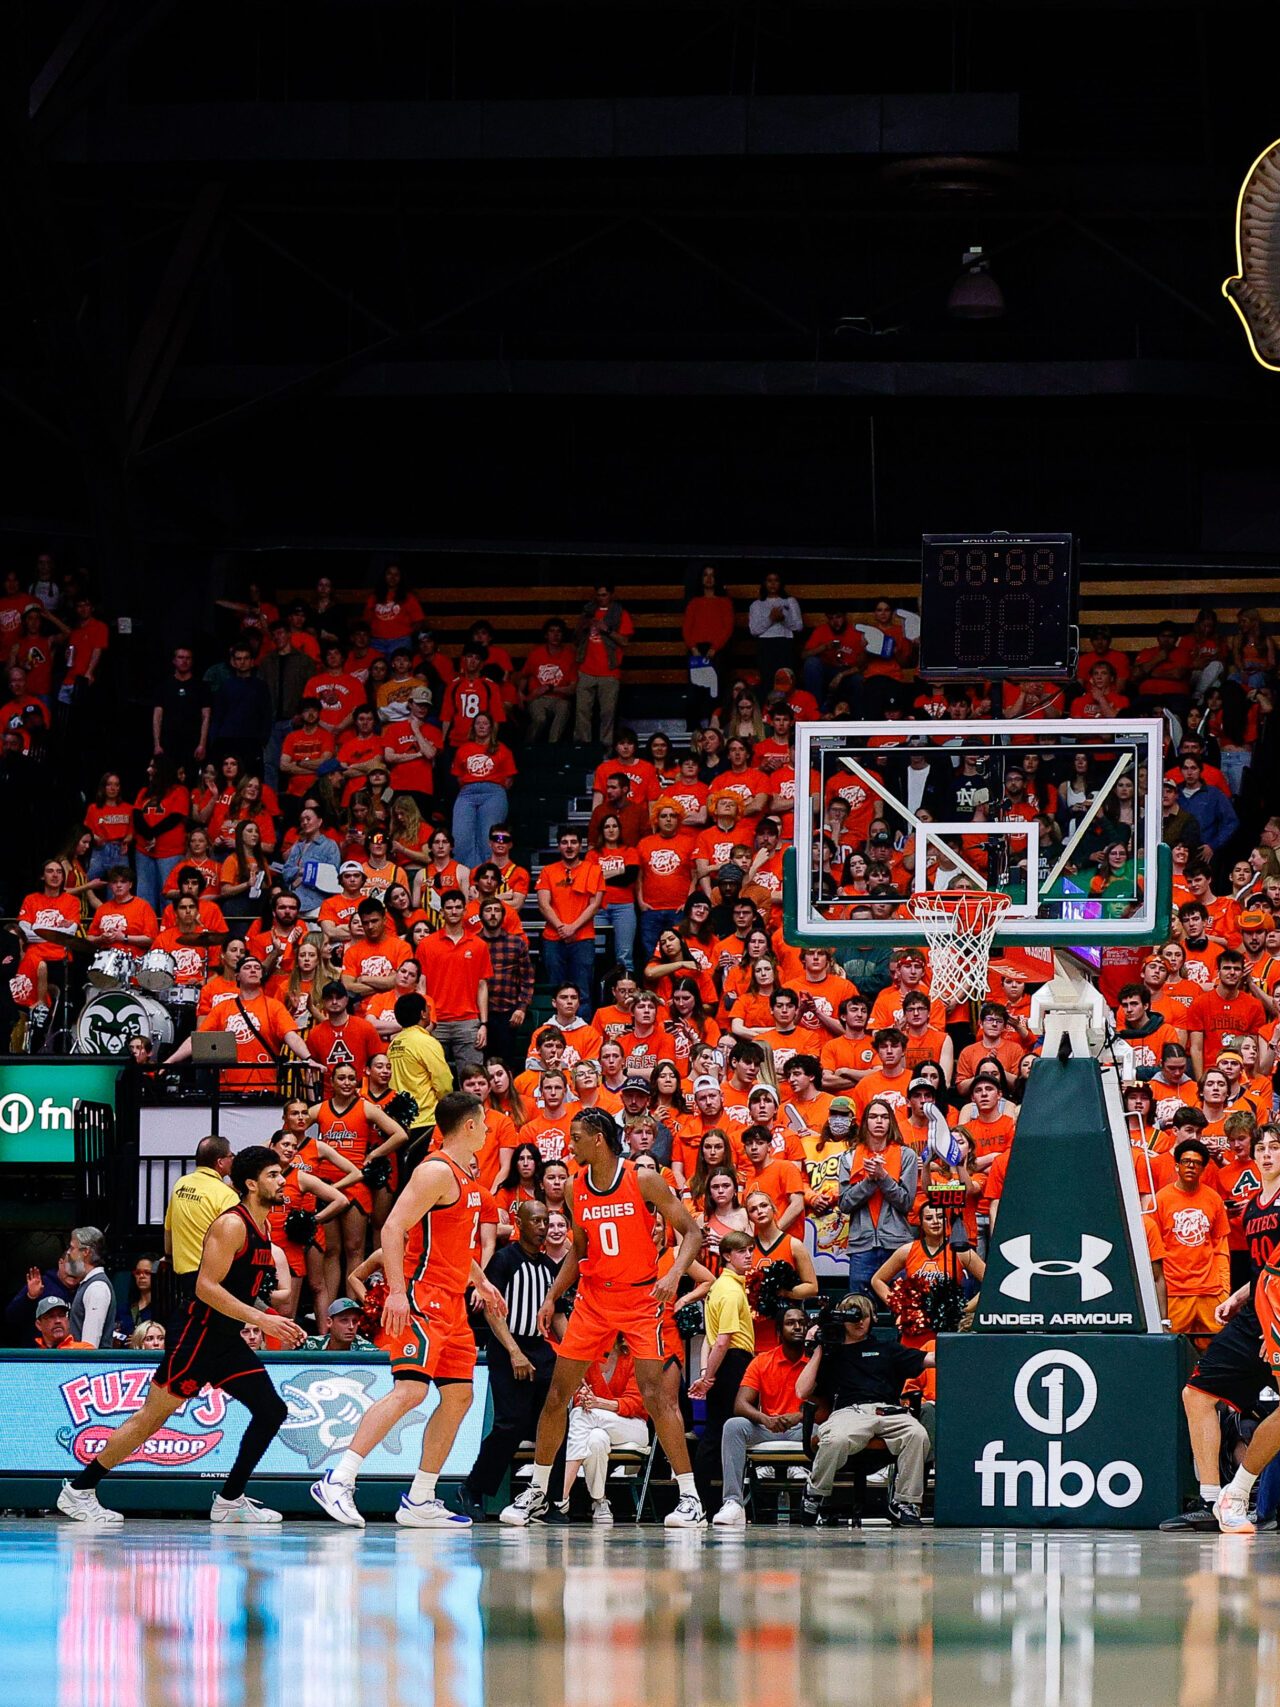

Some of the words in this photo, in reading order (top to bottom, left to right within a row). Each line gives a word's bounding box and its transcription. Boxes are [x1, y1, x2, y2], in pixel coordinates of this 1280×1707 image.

[460, 694, 480, 719] 18
[327, 1040, 354, 1064] A
[1232, 1169, 1260, 1196] A
[467, 1191, 481, 1209] AGGI
[582, 1203, 635, 1222] AGGIES
[1246, 1213, 1279, 1234] AZTECS
[599, 1222, 620, 1257] 0
[1252, 1235, 1276, 1266] 40
[979, 1312, 1055, 1325] UNDER
[1060, 1312, 1133, 1325] ARMOUR
[144, 1438, 207, 1455] SHOP
[974, 1440, 1143, 1508] fnbo
